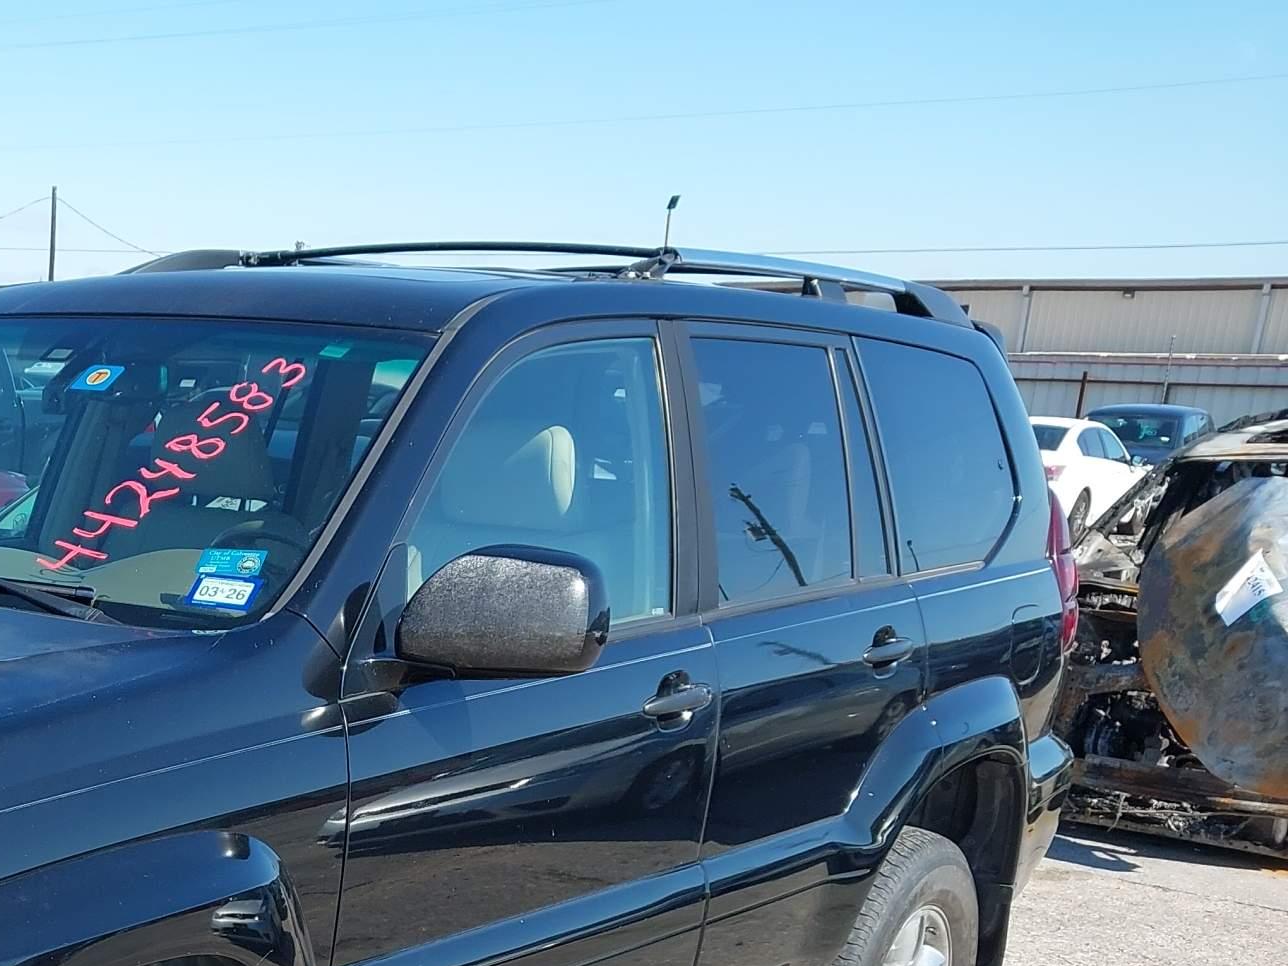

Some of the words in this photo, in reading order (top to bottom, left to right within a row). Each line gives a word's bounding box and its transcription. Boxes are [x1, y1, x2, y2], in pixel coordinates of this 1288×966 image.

[36, 357, 306, 569] 44248583
[199, 585, 219, 597] 03
[225, 588, 247, 600] 26
